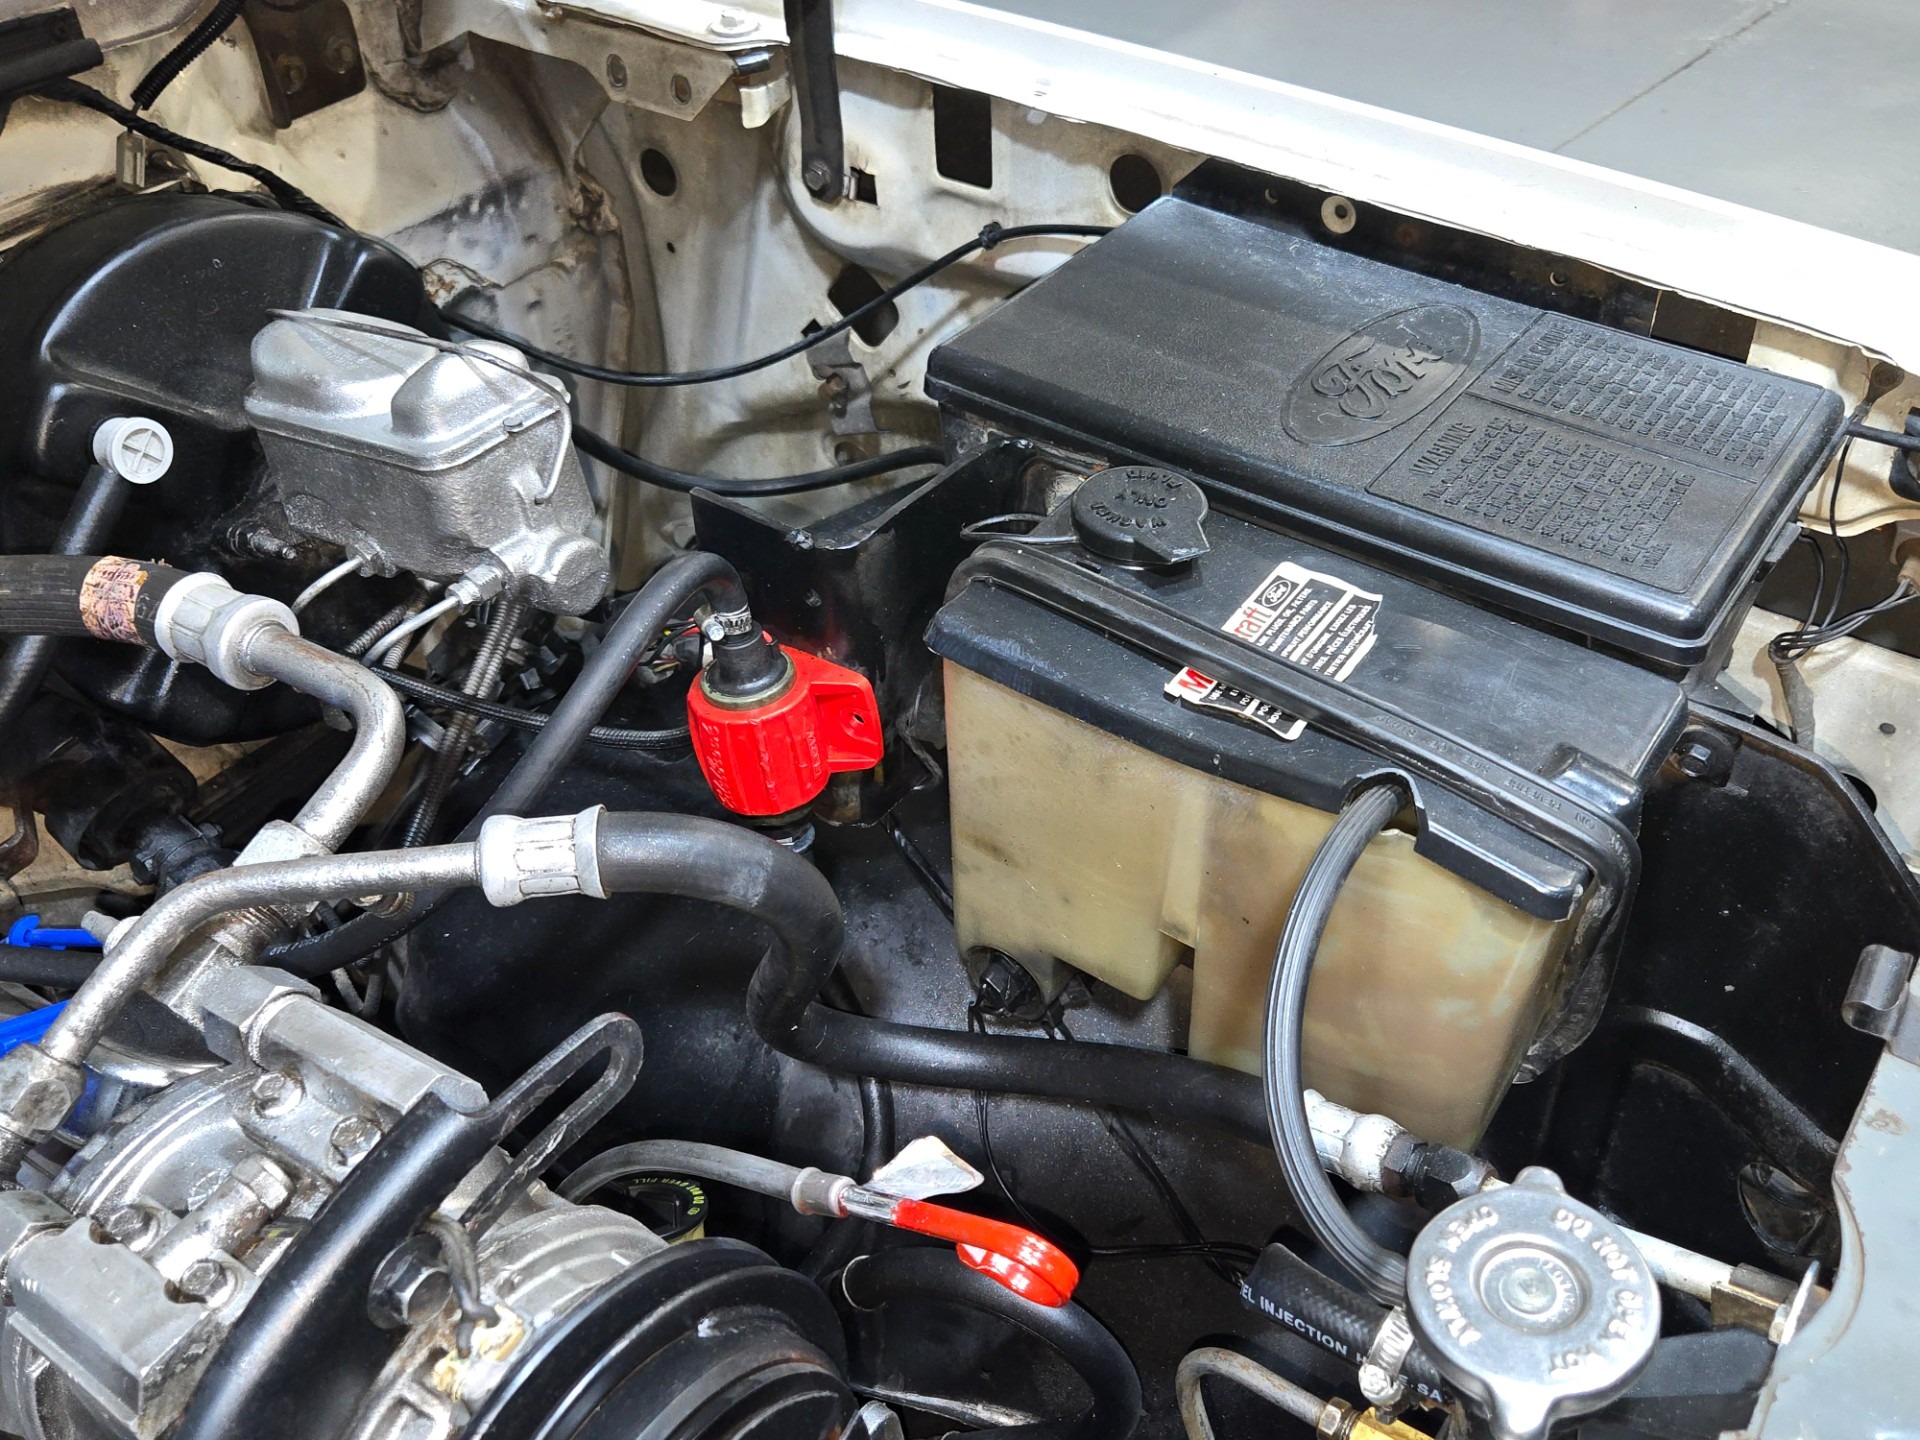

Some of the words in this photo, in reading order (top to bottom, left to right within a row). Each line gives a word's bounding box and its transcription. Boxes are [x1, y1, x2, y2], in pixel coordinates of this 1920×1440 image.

[1524, 322, 1574, 356] GARDE
[1311, 325, 1445, 421] Ford
[1488, 365, 1532, 394] MISE
[1511, 353, 1544, 370] EN
[1407, 420, 1478, 477] WARNING
[1267, 584, 1288, 603] Ford
[1267, 613, 1303, 653] MAINTENANCE
[1299, 599, 1319, 617] PARTS
[1299, 600, 1335, 642] PERFORMANCE
[1329, 612, 1350, 633] EXIGEZ
[1177, 667, 1216, 695] M
[1233, 605, 1273, 641] raft
[1323, 652, 1347, 677] TRETIEN
[1342, 619, 1375, 656] MOTORCRAFT
[1208, 689, 1223, 701] USE
[806, 730, 822, 778] FLOW
[1460, 752, 1493, 776] SIDE
[1574, 811, 1597, 831] ON
[661, 1177, 690, 1188] OVER
[1552, 1207, 1593, 1241] DO
[1592, 1235, 1639, 1283] NOT
[1259, 1295, 1349, 1357] INJECTION
